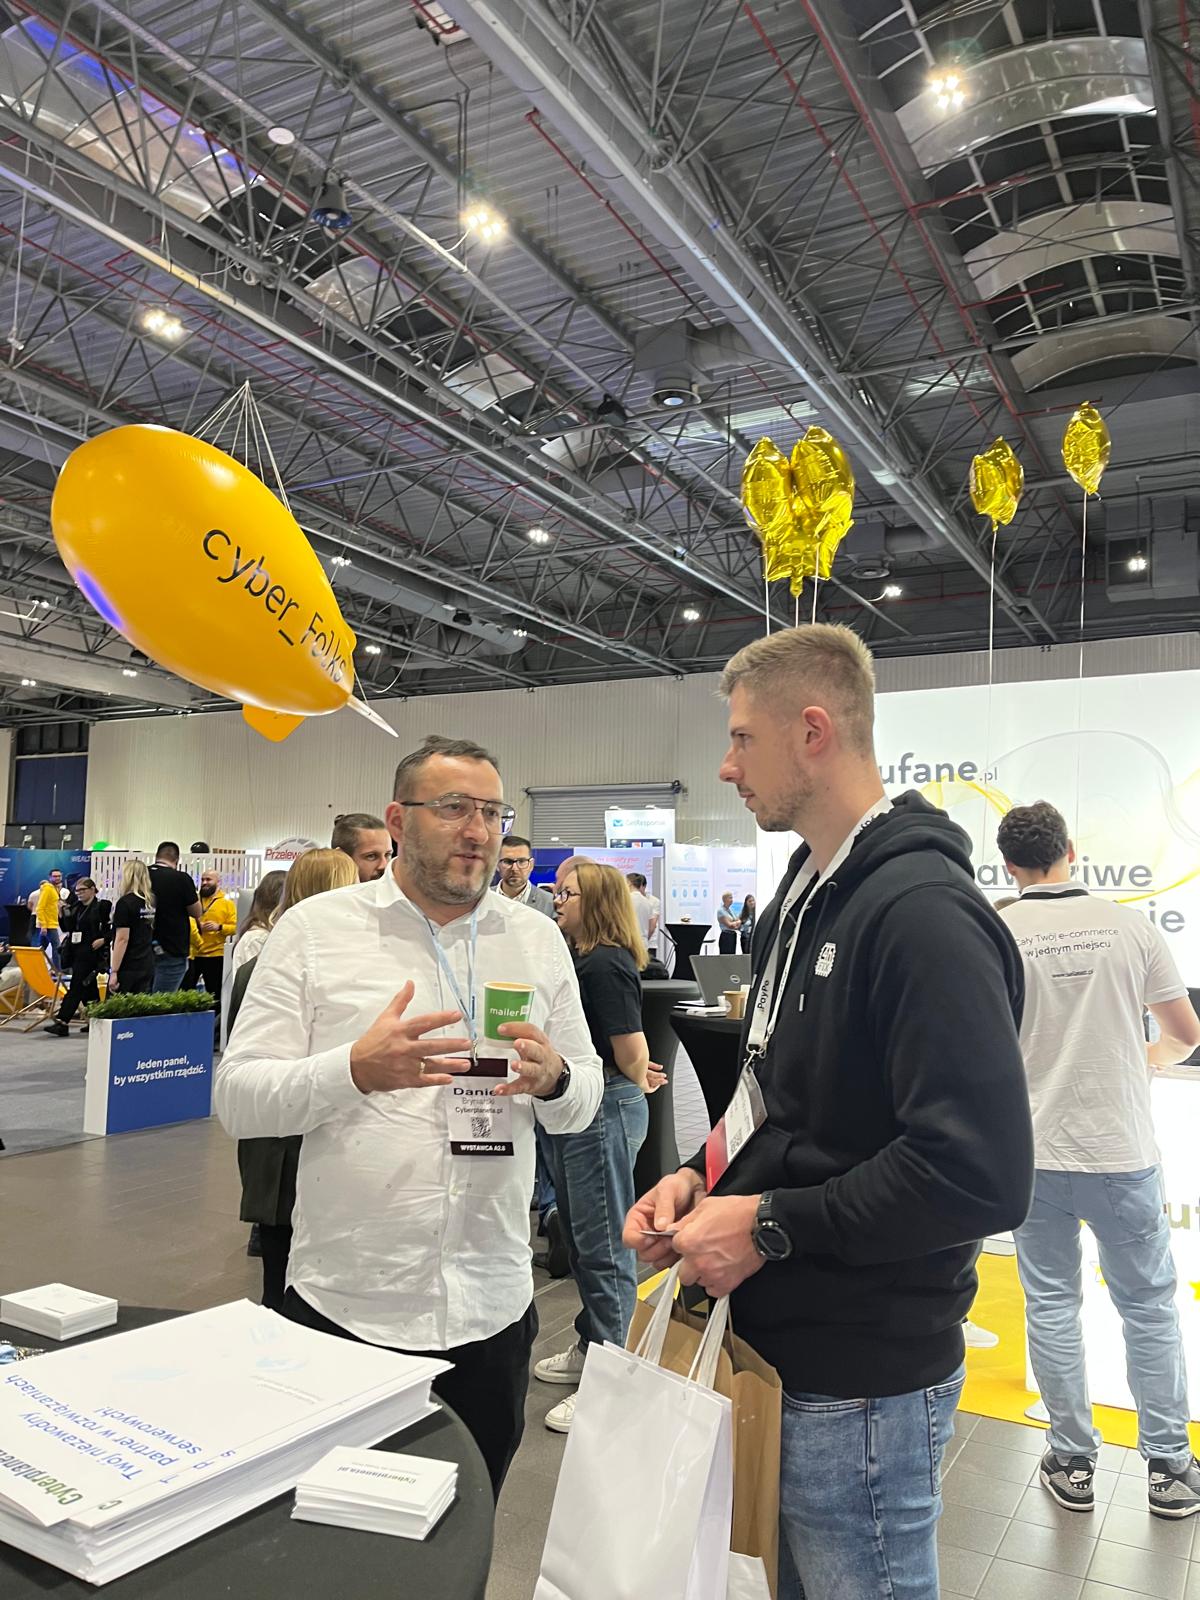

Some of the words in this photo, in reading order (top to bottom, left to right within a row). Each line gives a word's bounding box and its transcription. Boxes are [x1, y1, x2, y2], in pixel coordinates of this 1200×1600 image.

[203, 529, 347, 682] cyber_Folks
[1058, 927, 1119, 940] e-commerce
[1034, 944, 1071, 958] jednym
[1073, 940, 1111, 951] miejscu
[113, 1075, 126, 1086] by
[127, 1068, 173, 1083] wszystkim
[175, 1063, 206, 1078] rządzić.
[136, 1059, 162, 1070] Jeden
[163, 1055, 189, 1068] panel,
[5, 1374, 101, 1432] rozwiązaniach
[20, 1412, 106, 1458] niezawodny
[94, 1407, 202, 1455] serwerowych!
[100, 1429, 117, 1438] w
[114, 1436, 180, 1466] partner
